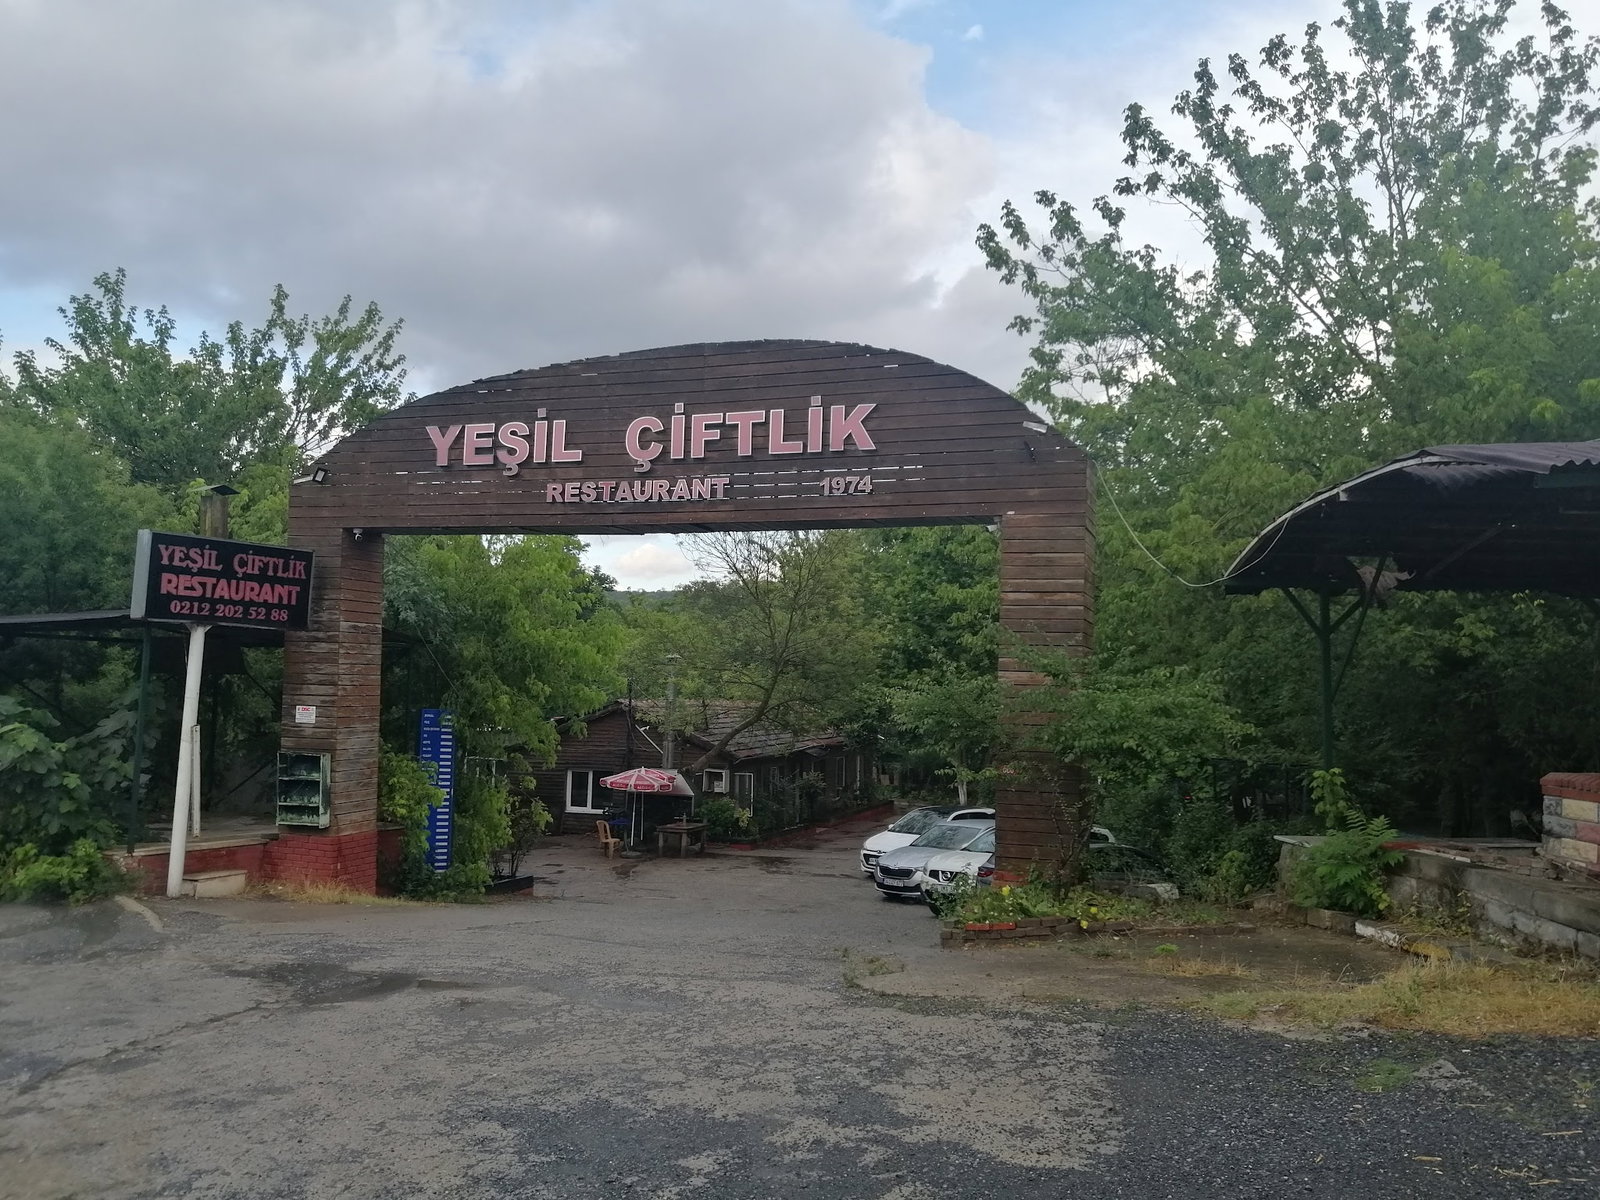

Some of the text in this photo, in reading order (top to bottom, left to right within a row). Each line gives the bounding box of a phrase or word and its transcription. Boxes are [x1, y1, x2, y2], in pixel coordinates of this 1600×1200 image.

[425, 395, 878, 476] YEŞİL ÇİFTLİK
[546, 475, 873, 503] RESTAURANT 1974
[158, 544, 306, 579] YEŞİL ÇİFTLİK
[160, 572, 301, 606] RESTAURANT
[170, 600, 288, 621] 0212 202 52 88
